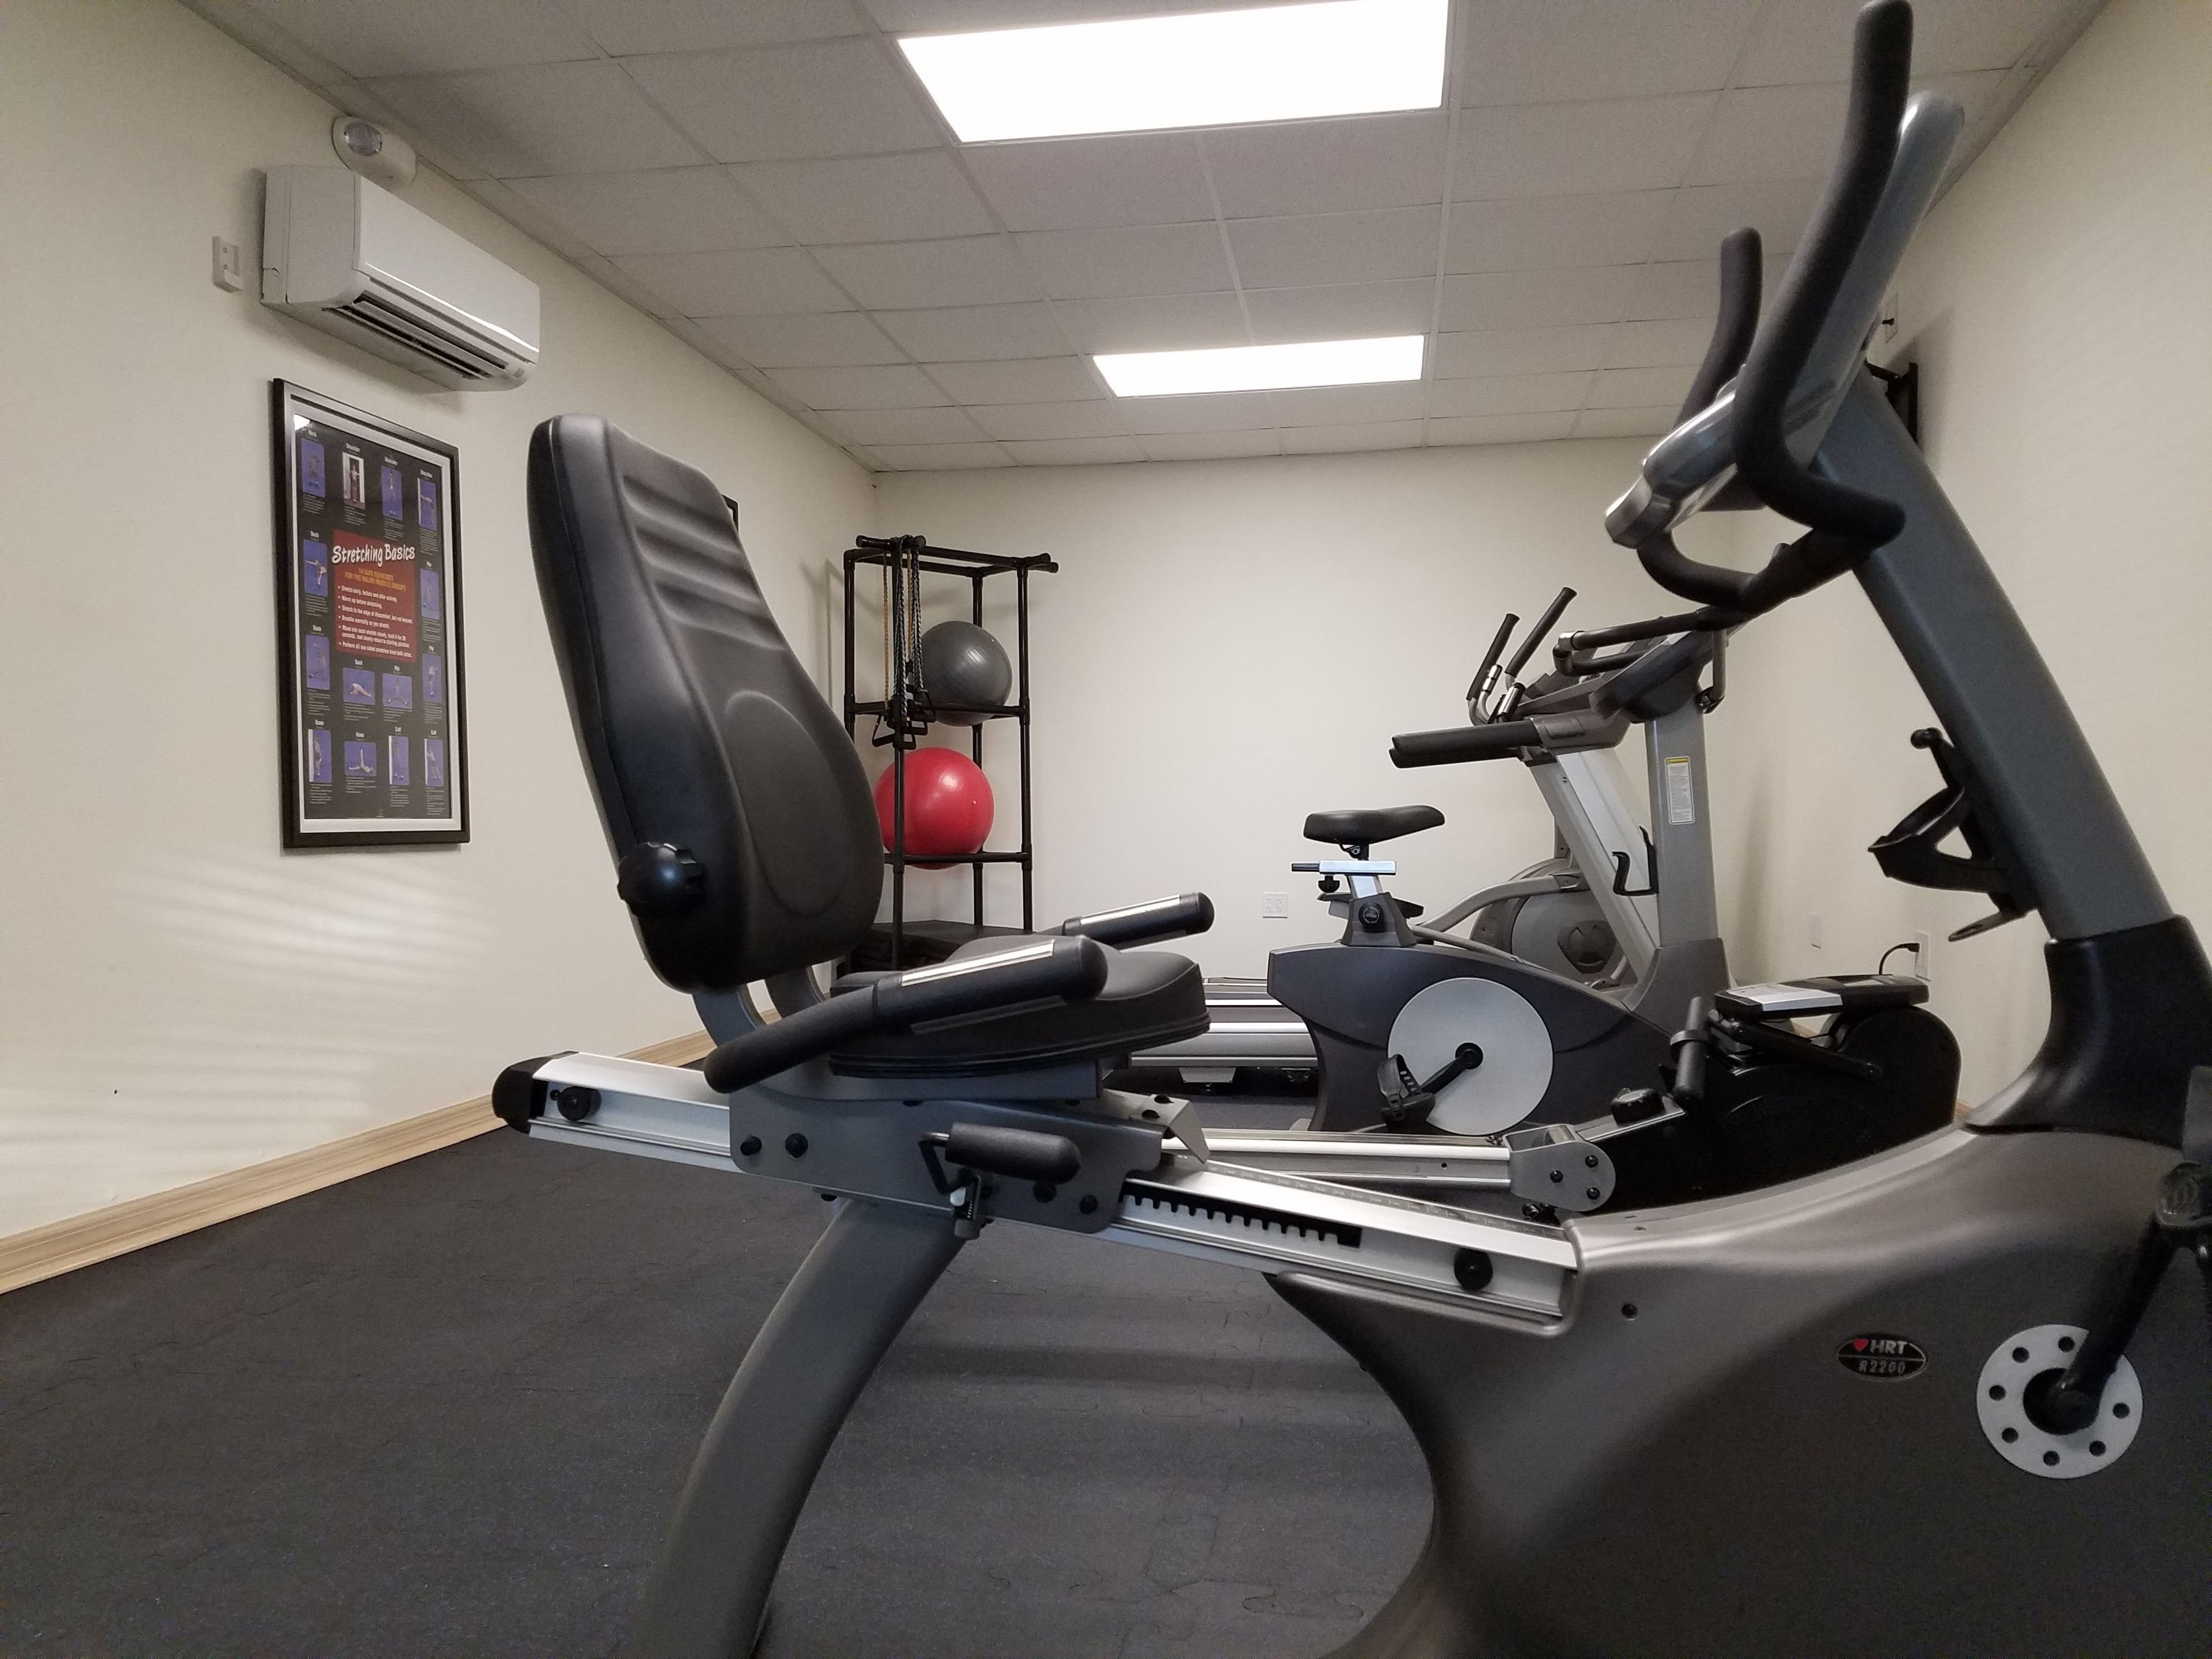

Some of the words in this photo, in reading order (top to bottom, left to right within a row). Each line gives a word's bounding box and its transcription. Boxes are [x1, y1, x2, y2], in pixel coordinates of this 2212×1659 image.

[332, 543, 383, 567] Stretching
[384, 543, 415, 560] Basics
[1870, 1339, 1907, 1355] HRT
